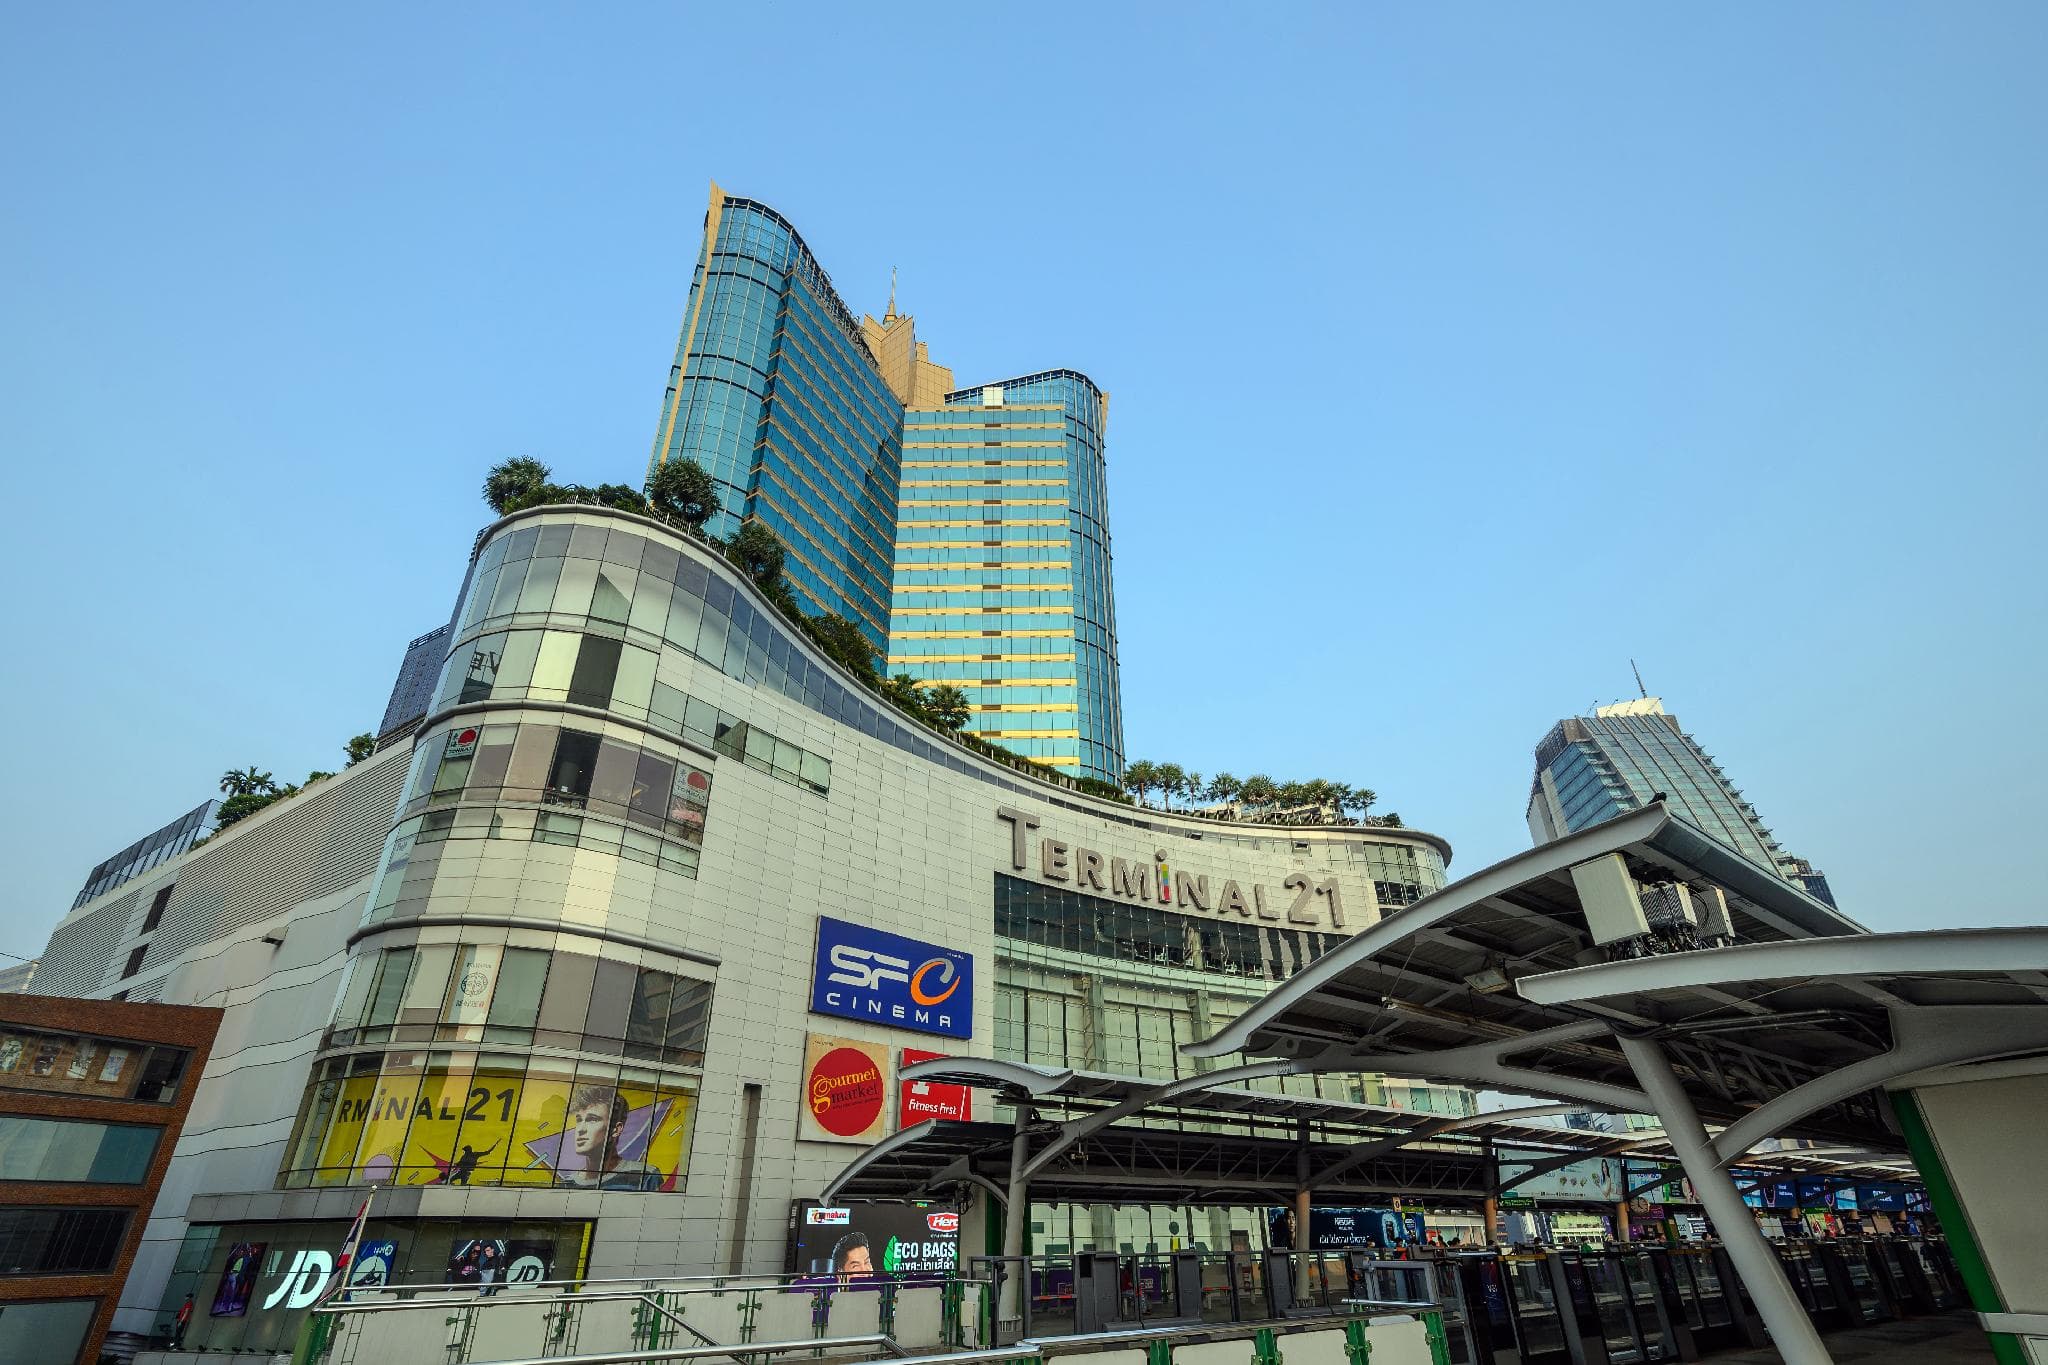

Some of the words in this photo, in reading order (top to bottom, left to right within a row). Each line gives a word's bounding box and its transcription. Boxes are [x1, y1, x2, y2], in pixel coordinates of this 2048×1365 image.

[826, 992, 951, 1028] CINEMA
[908, 1098, 938, 1113] Fitness
[939, 1102, 957, 1115] First
[893, 1242, 919, 1259] ECO
[922, 1241, 956, 1258] BAGS
[263, 1250, 333, 1310] JD
[510, 1264, 540, 1283] JD
